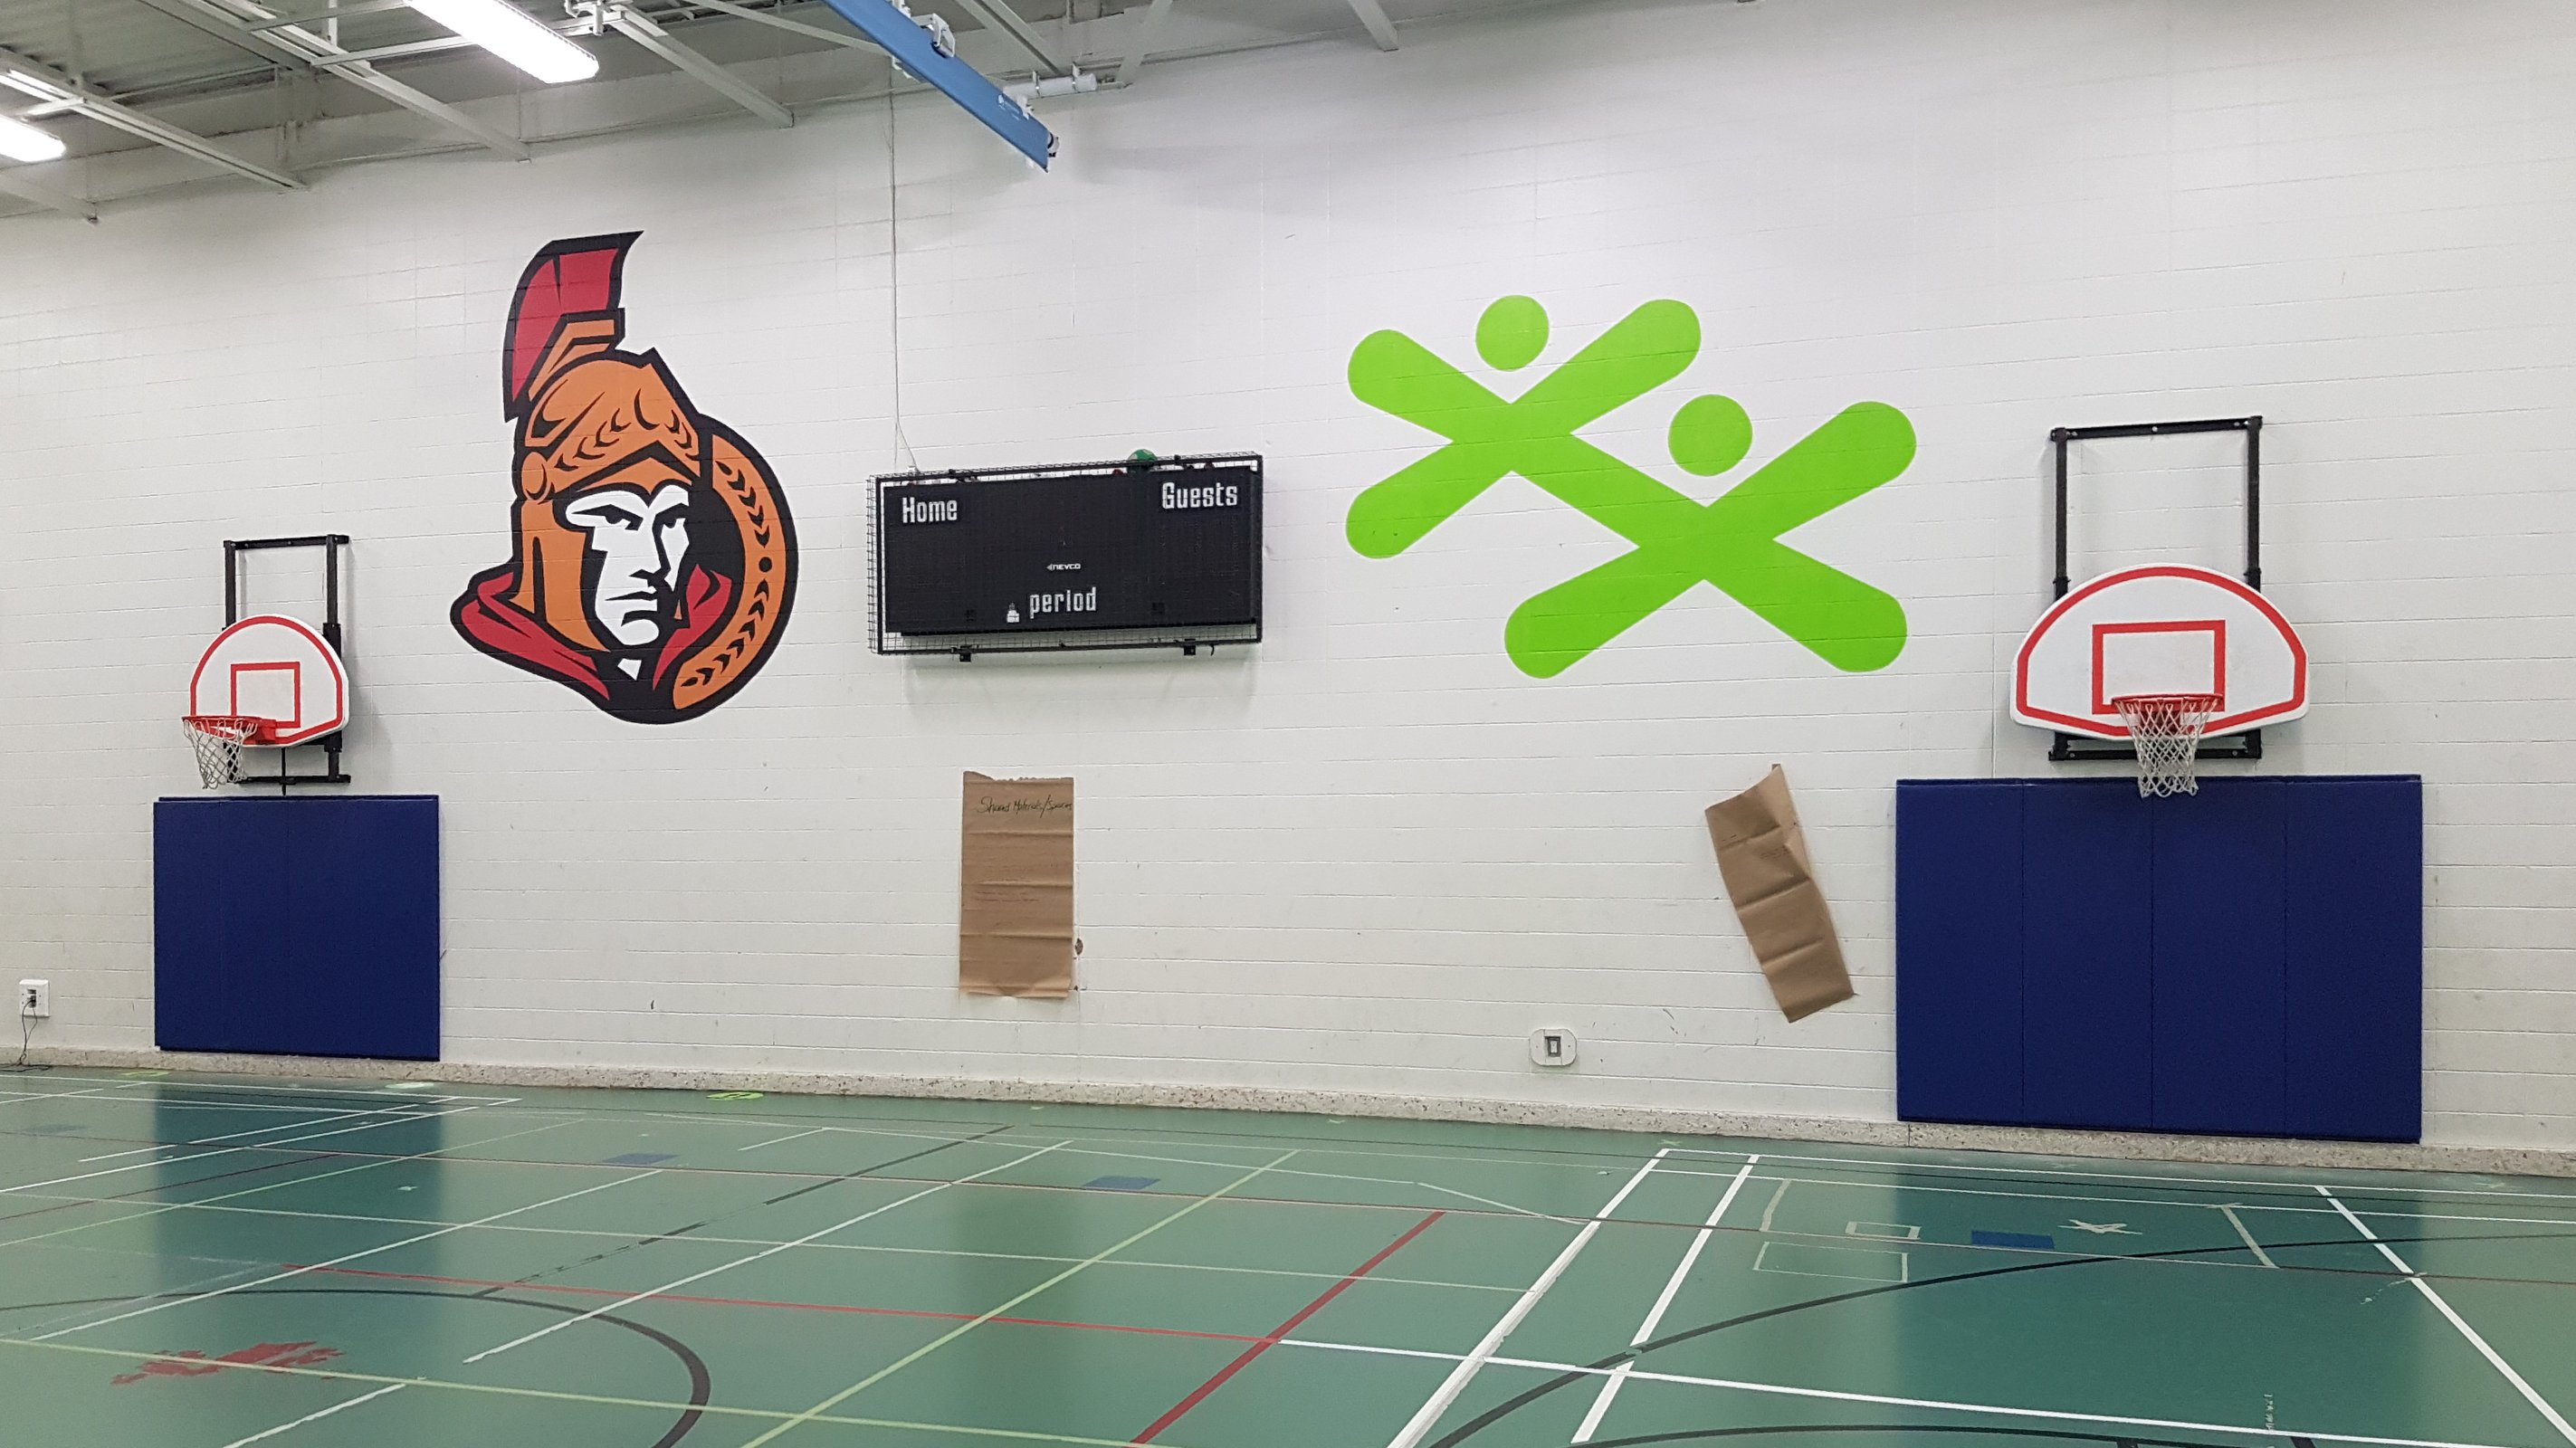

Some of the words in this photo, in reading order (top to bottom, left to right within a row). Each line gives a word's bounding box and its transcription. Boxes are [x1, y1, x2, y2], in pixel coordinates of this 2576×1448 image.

[1162, 482, 1237, 509] Guests
[902, 497, 958, 523] Home
[1030, 586, 1096, 619] period
